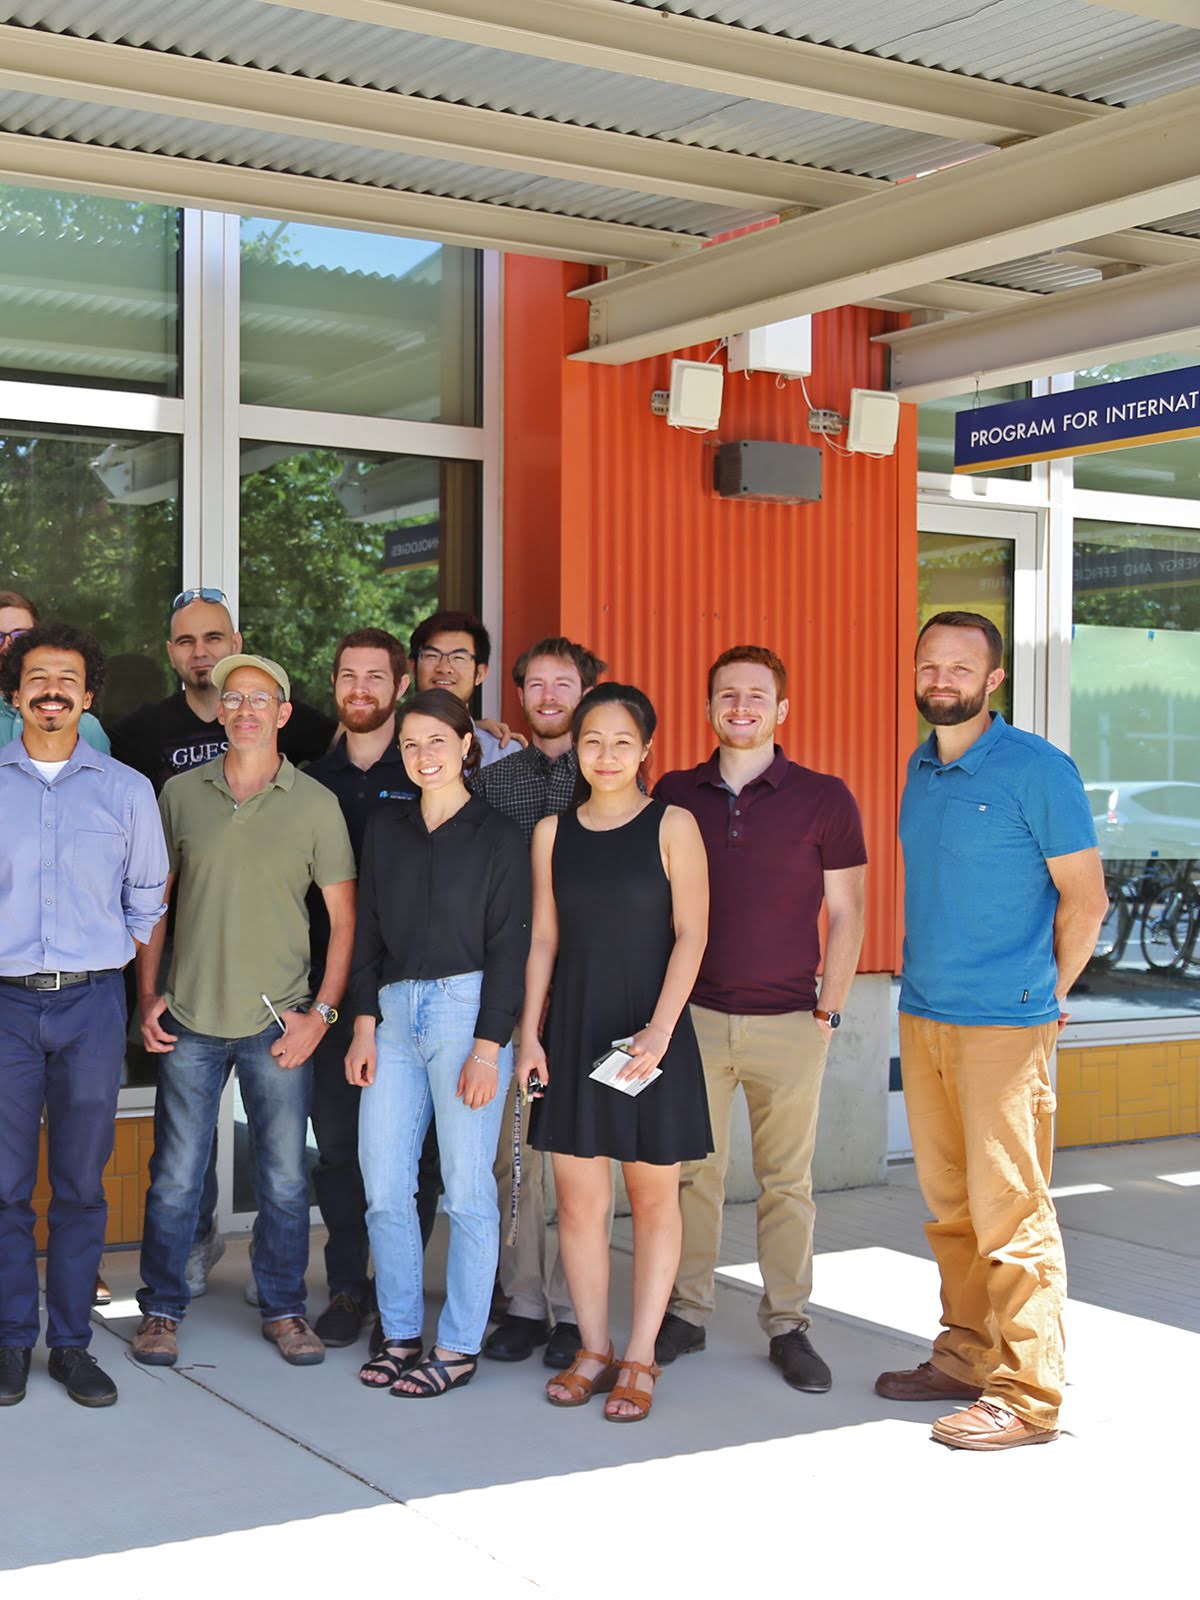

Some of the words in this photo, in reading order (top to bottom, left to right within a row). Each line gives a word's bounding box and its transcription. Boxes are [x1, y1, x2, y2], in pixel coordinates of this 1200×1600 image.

[970, 418, 1056, 448] PROGRAM
[1062, 410, 1098, 432] FOR
[1105, 391, 1200, 424] INTERNAT
